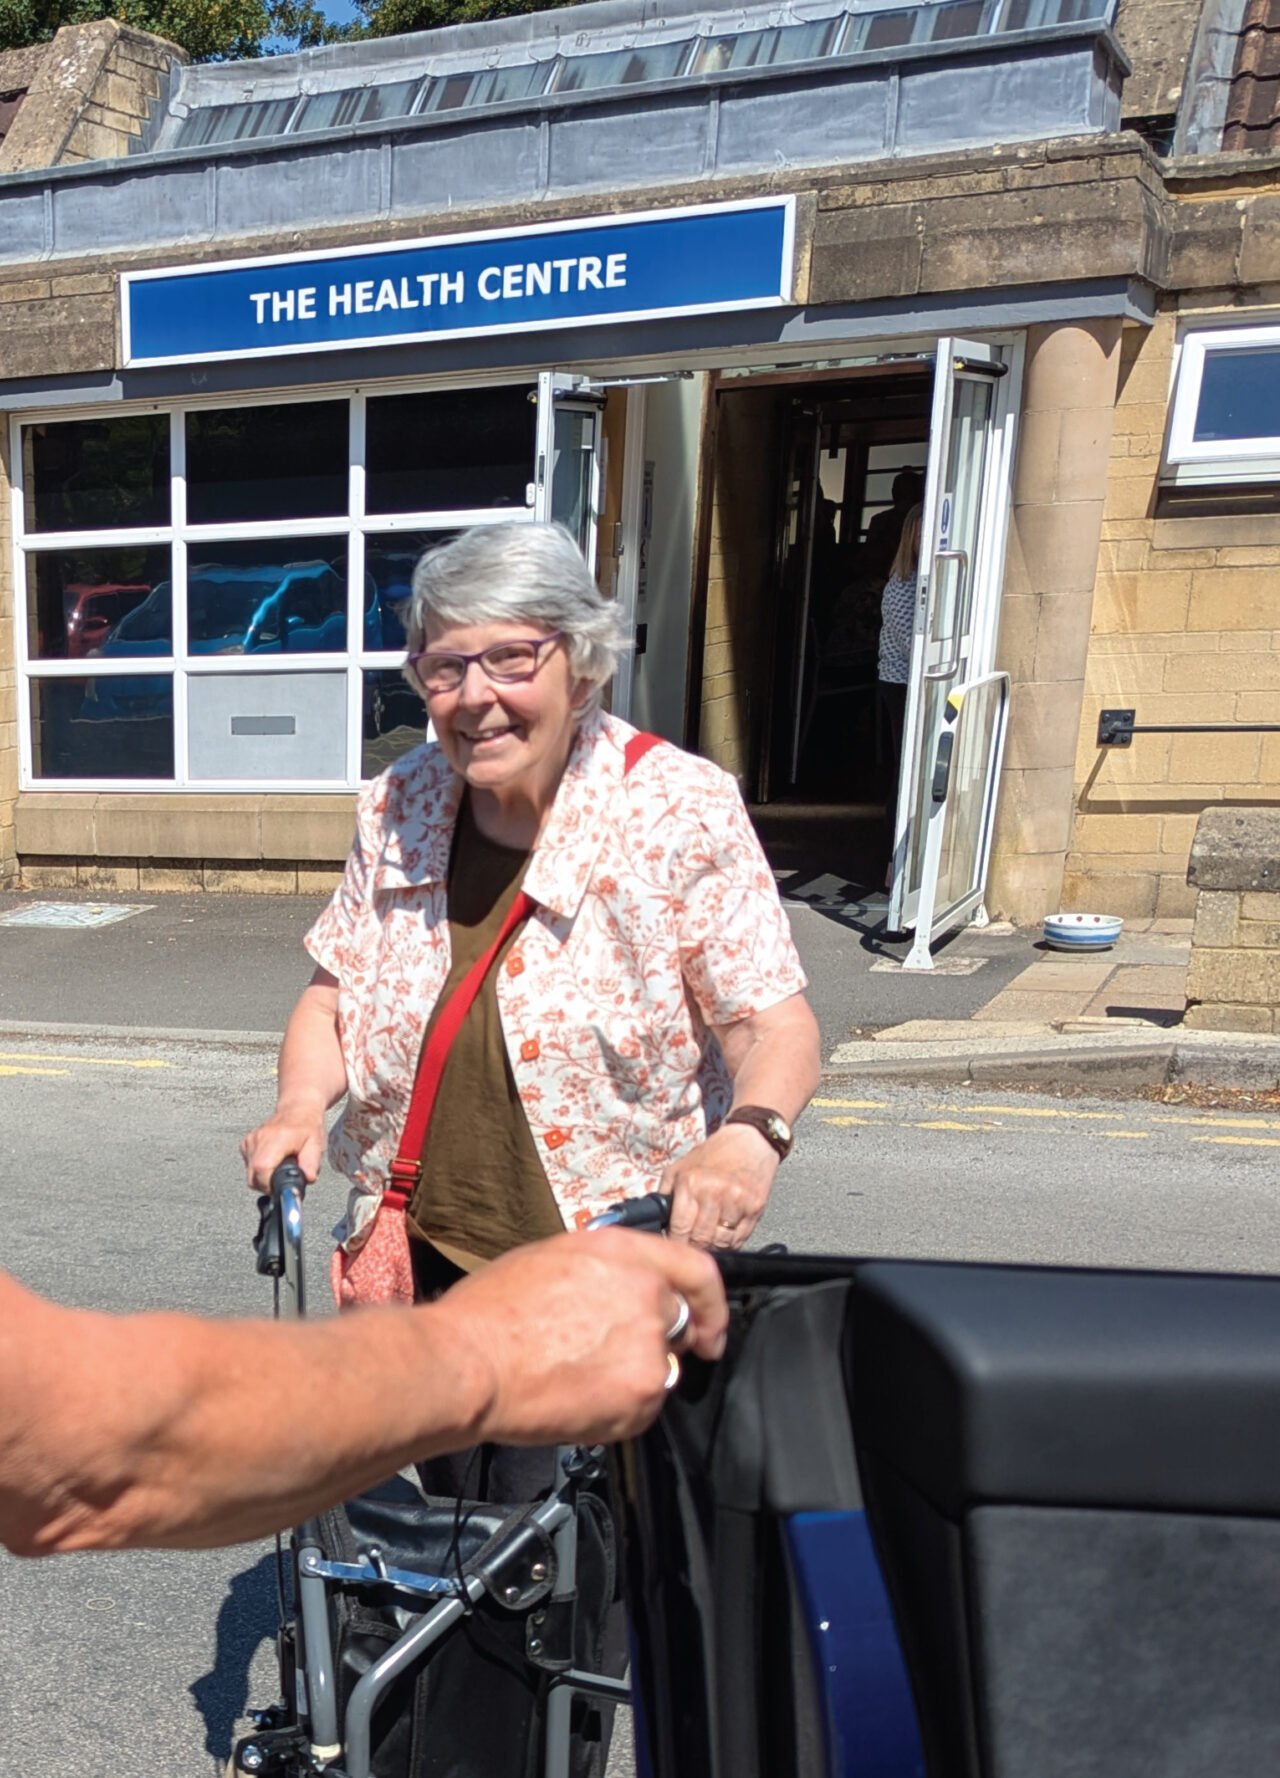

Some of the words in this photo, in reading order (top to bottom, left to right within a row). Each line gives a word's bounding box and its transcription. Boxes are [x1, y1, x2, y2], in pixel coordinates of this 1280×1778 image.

[249, 287, 317, 324] THE
[328, 271, 464, 316] HEALTH
[477, 253, 627, 300] CENTRE
